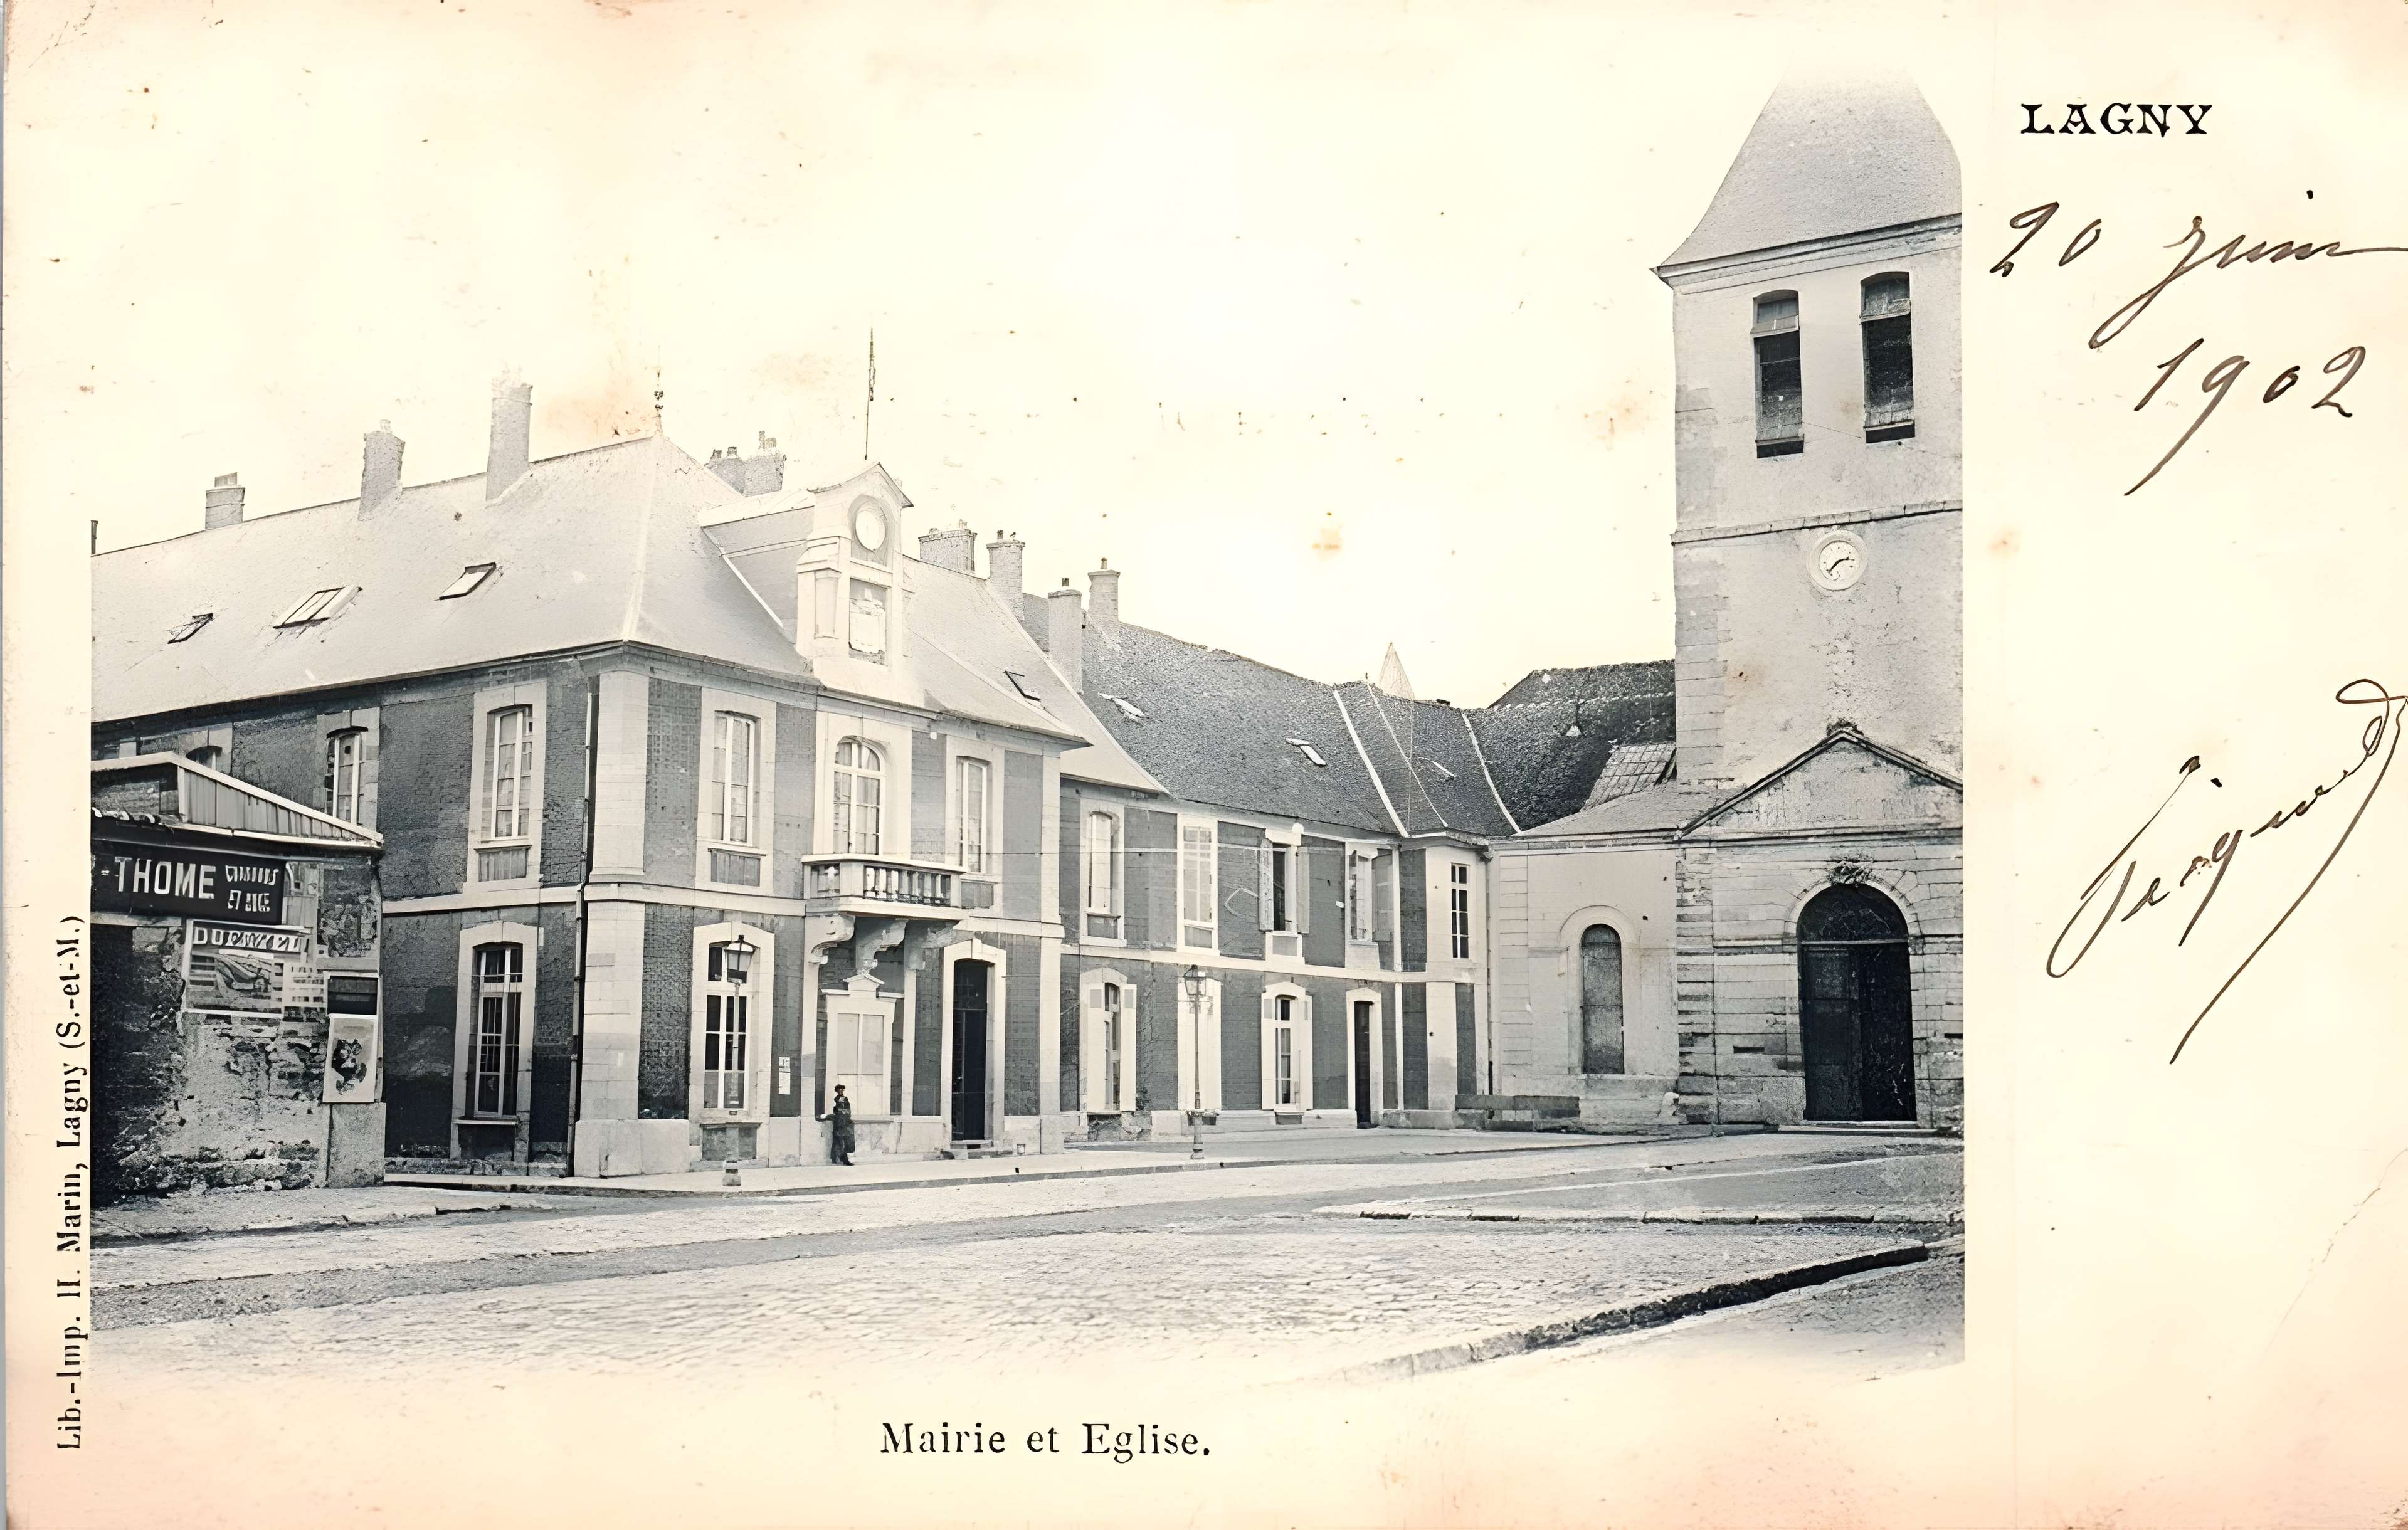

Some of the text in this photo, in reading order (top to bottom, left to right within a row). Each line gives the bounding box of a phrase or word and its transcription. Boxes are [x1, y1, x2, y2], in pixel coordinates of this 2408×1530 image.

[1989, 201, 2102, 278] 20
[2124, 337, 2366, 496] 1902
[114, 855, 216, 900] THOME
